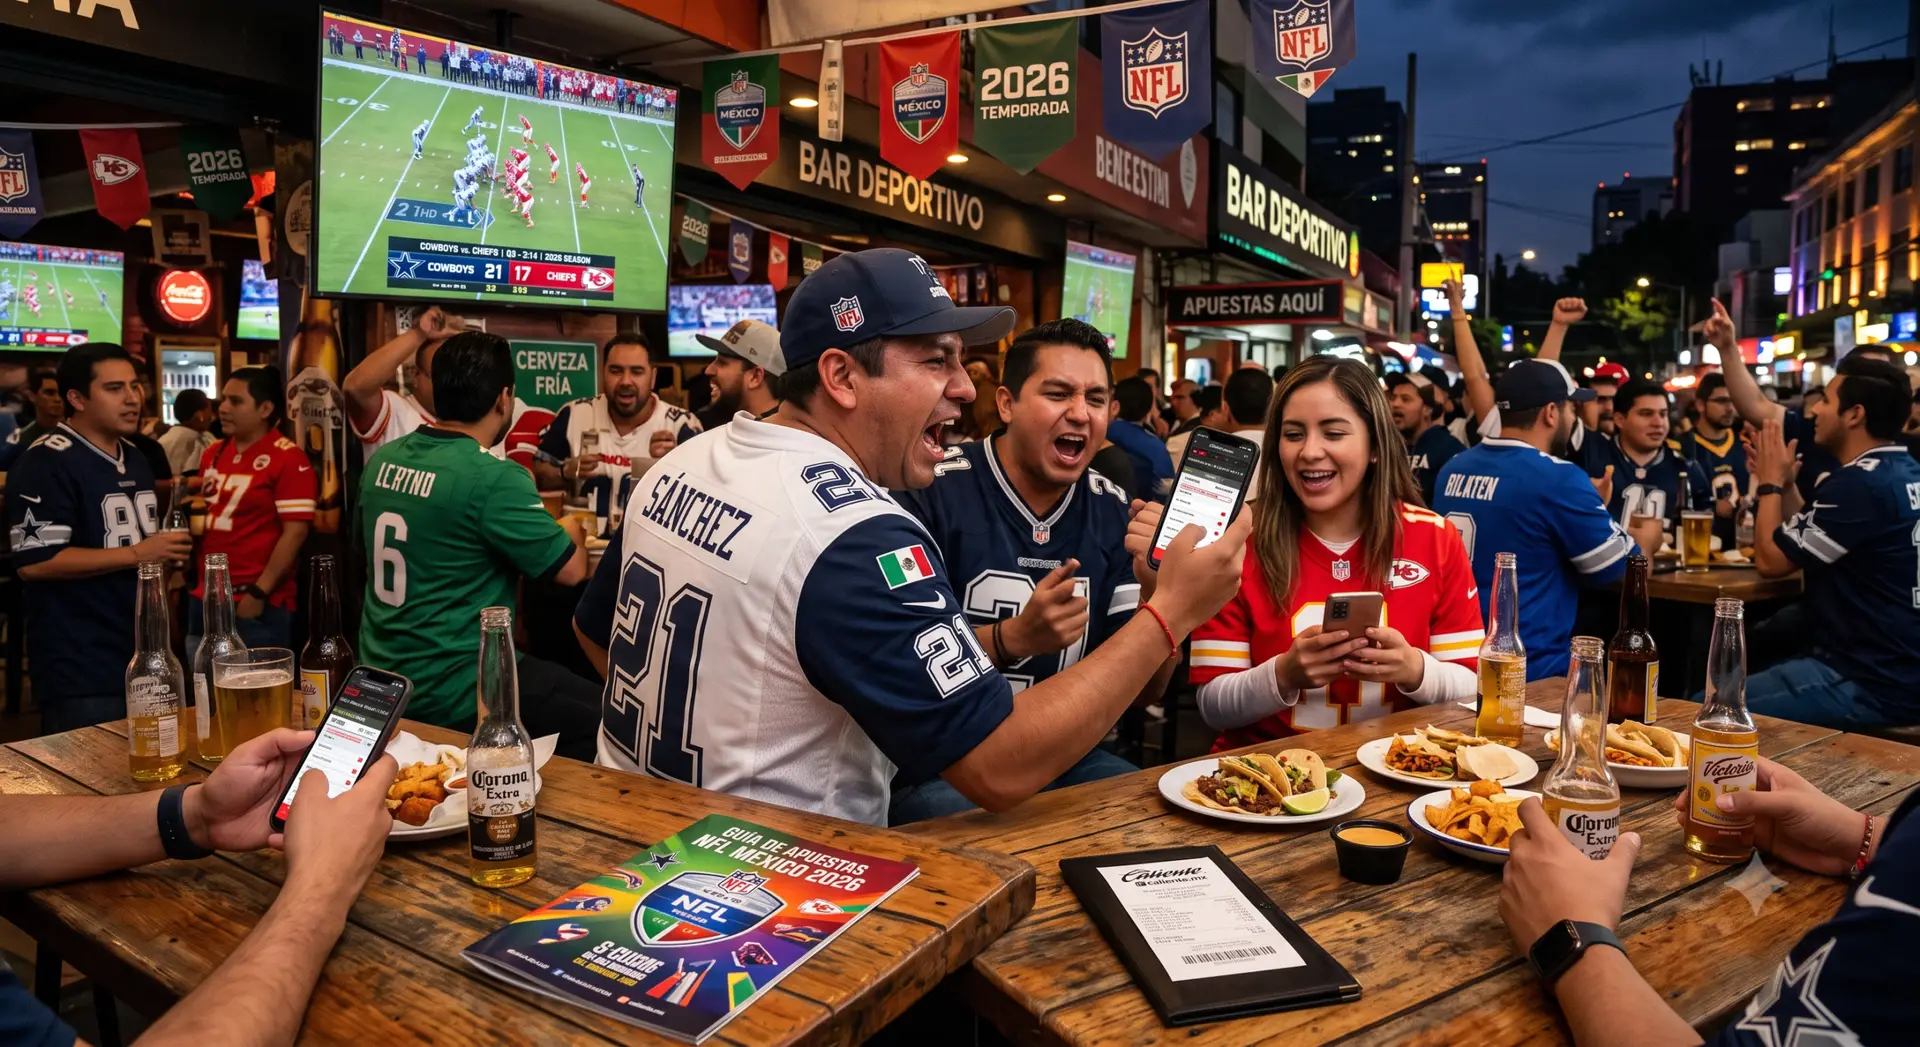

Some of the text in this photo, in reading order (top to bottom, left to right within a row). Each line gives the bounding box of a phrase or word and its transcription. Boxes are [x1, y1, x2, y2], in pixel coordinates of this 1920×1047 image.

[1281, 26, 1326, 60] NFL
[981, 61, 1070, 101] 2026
[1130, 65, 1182, 104] NFL
[897, 96, 941, 112] MÉXICO
[980, 100, 1070, 120] TEMPORADA
[188, 150, 242, 173] 2026
[191, 171, 248, 185] TEMPORADA
[799, 139, 984, 231] BAR DEPORTIVO
[681, 215, 709, 238] 2026
[1227, 163, 1348, 269] BAR DEPORTIVO
[420, 242, 459, 253] COWBOYS
[472, 246, 499, 257] CHIEFS
[564, 255, 591, 264] SEASON
[428, 262, 475, 275] COWBOYS
[484, 264, 502, 280] 21
[514, 266, 532, 282] 17
[546, 271, 577, 282] CHIEFS
[1183, 288, 1324, 316] APUESTAS AQUÍ
[837, 309, 860, 328] NFL
[515, 351, 589, 371] CERVEZA
[535, 372, 572, 396] FRÍA
[642, 471, 753, 561] SÁNCHEZ
[373, 511, 408, 608] 6
[913, 612, 995, 699] 21
[601, 551, 713, 788] 21
[472, 769, 528, 791] Corona
[486, 787, 519, 799] Extra
[721, 826, 869, 875] GUÍA DE APUESTAS
[691, 833, 866, 892] NFL MEXICO 2026
[720, 878, 755, 894] NFL
[1121, 866, 1202, 883] Caliente
[1147, 875, 1208, 886] caliente.mx
[672, 894, 728, 924] NFL
